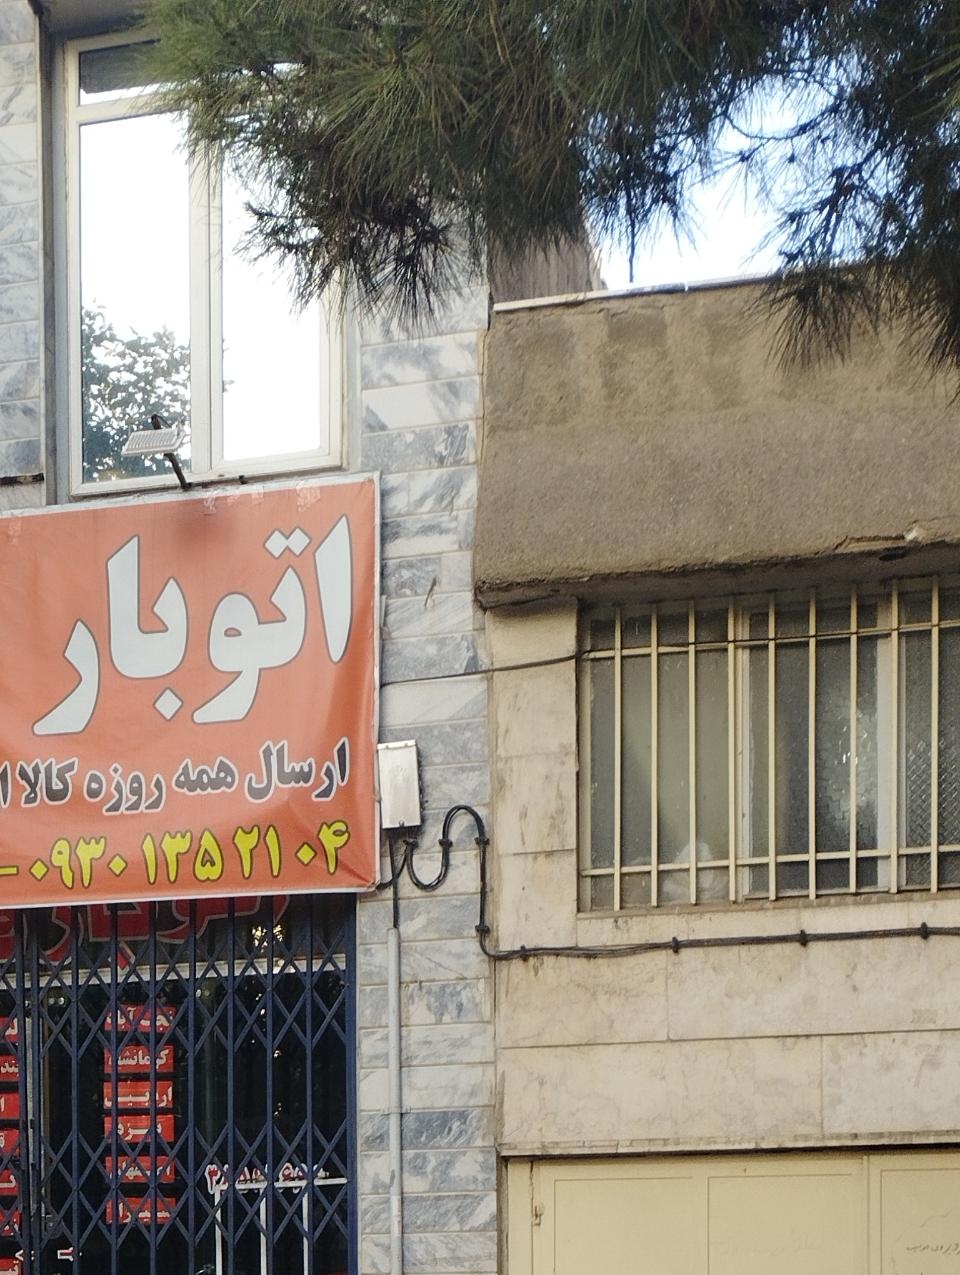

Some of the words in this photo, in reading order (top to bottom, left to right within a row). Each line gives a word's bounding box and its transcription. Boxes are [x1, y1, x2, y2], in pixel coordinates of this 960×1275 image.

[32, 514, 353, 736] اتوبار
[16, 758, 79, 807] کالا
[84, 763, 165, 815] روزه
[172, 756, 238, 794] همه
[243, 737, 350, 802] ارسال
